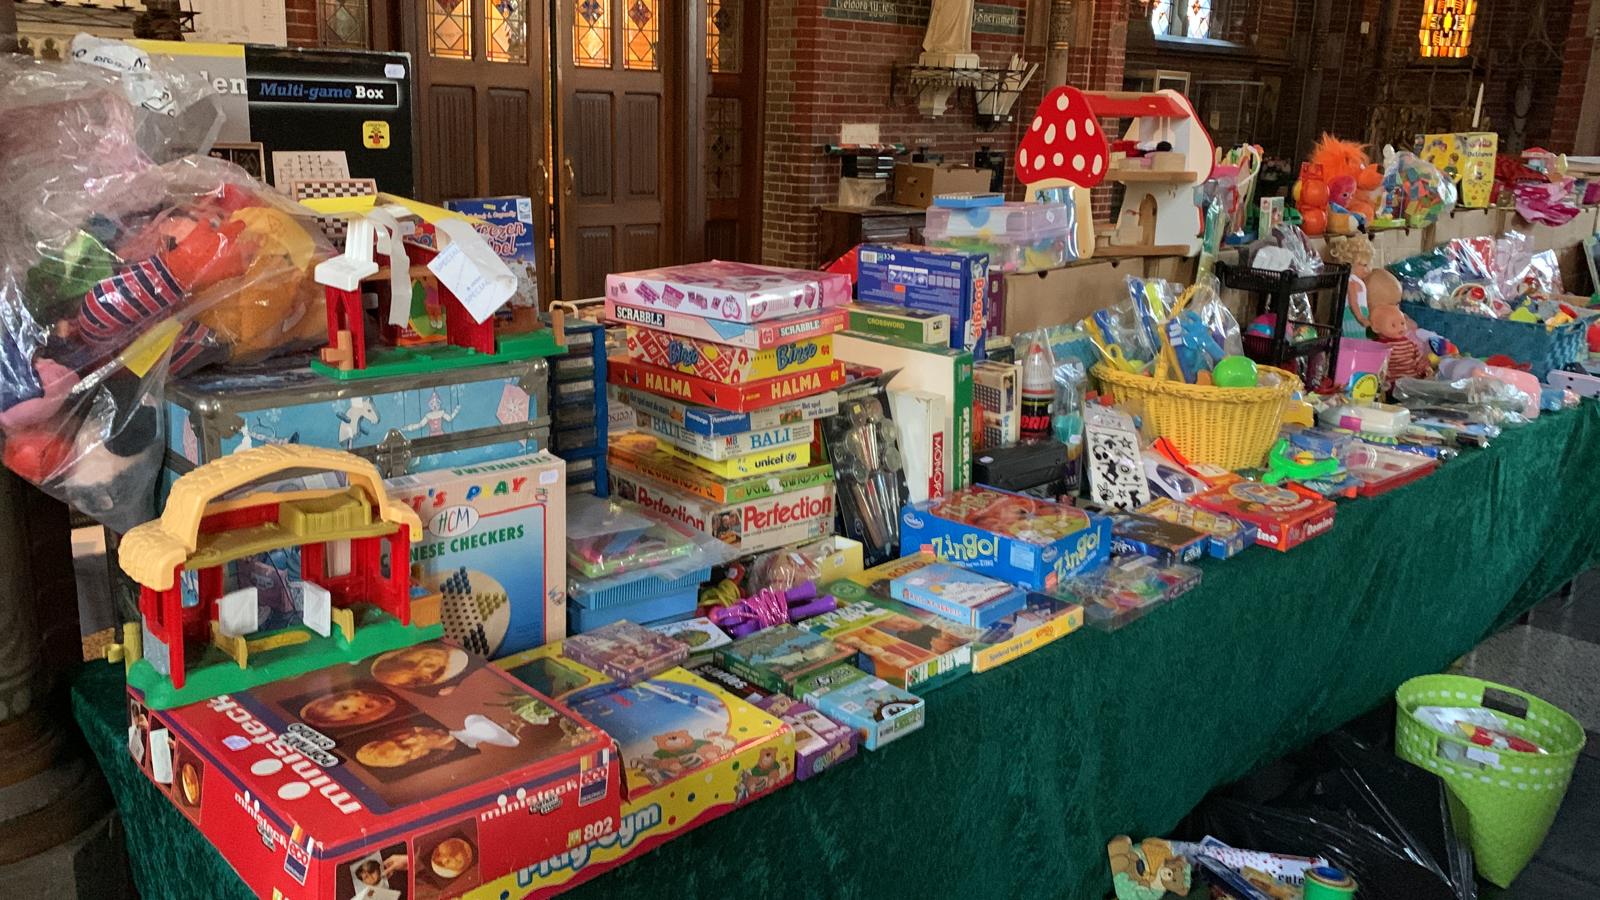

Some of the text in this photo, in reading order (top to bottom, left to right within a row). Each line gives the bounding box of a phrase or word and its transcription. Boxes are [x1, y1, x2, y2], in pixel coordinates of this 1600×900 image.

[259, 82, 384, 100] Multi-game Box
[616, 306, 663, 326] SCRABBLE
[972, 278, 986, 338] Boggle
[780, 320, 821, 336] SCRABBLE
[867, 317, 905, 329] CROSSWORD
[668, 341, 699, 367] Bingo
[776, 342, 817, 371] Bingo
[645, 372, 692, 398] HALMA
[771, 372, 822, 399] HALMA
[653, 416, 681, 440] BALI
[751, 427, 791, 450] BALI
[961, 407, 971, 488] SPEL DER SPE
[452, 455, 553, 476] STERNHALMA
[755, 454, 784, 469] unicef
[466, 476, 528, 501] PLAY
[438, 508, 470, 534] HCM
[638, 485, 706, 532] Perfection
[743, 494, 833, 533] Perfection
[450, 524, 525, 553] CHECKERS
[931, 532, 999, 562] Zingo!
[1053, 525, 1101, 579] Zingo!
[209, 694, 363, 815] ministeck
[481, 778, 579, 822] ministeck
[234, 790, 288, 850] ministeck
[584, 816, 614, 841] 802
[288, 843, 309, 866] eco
